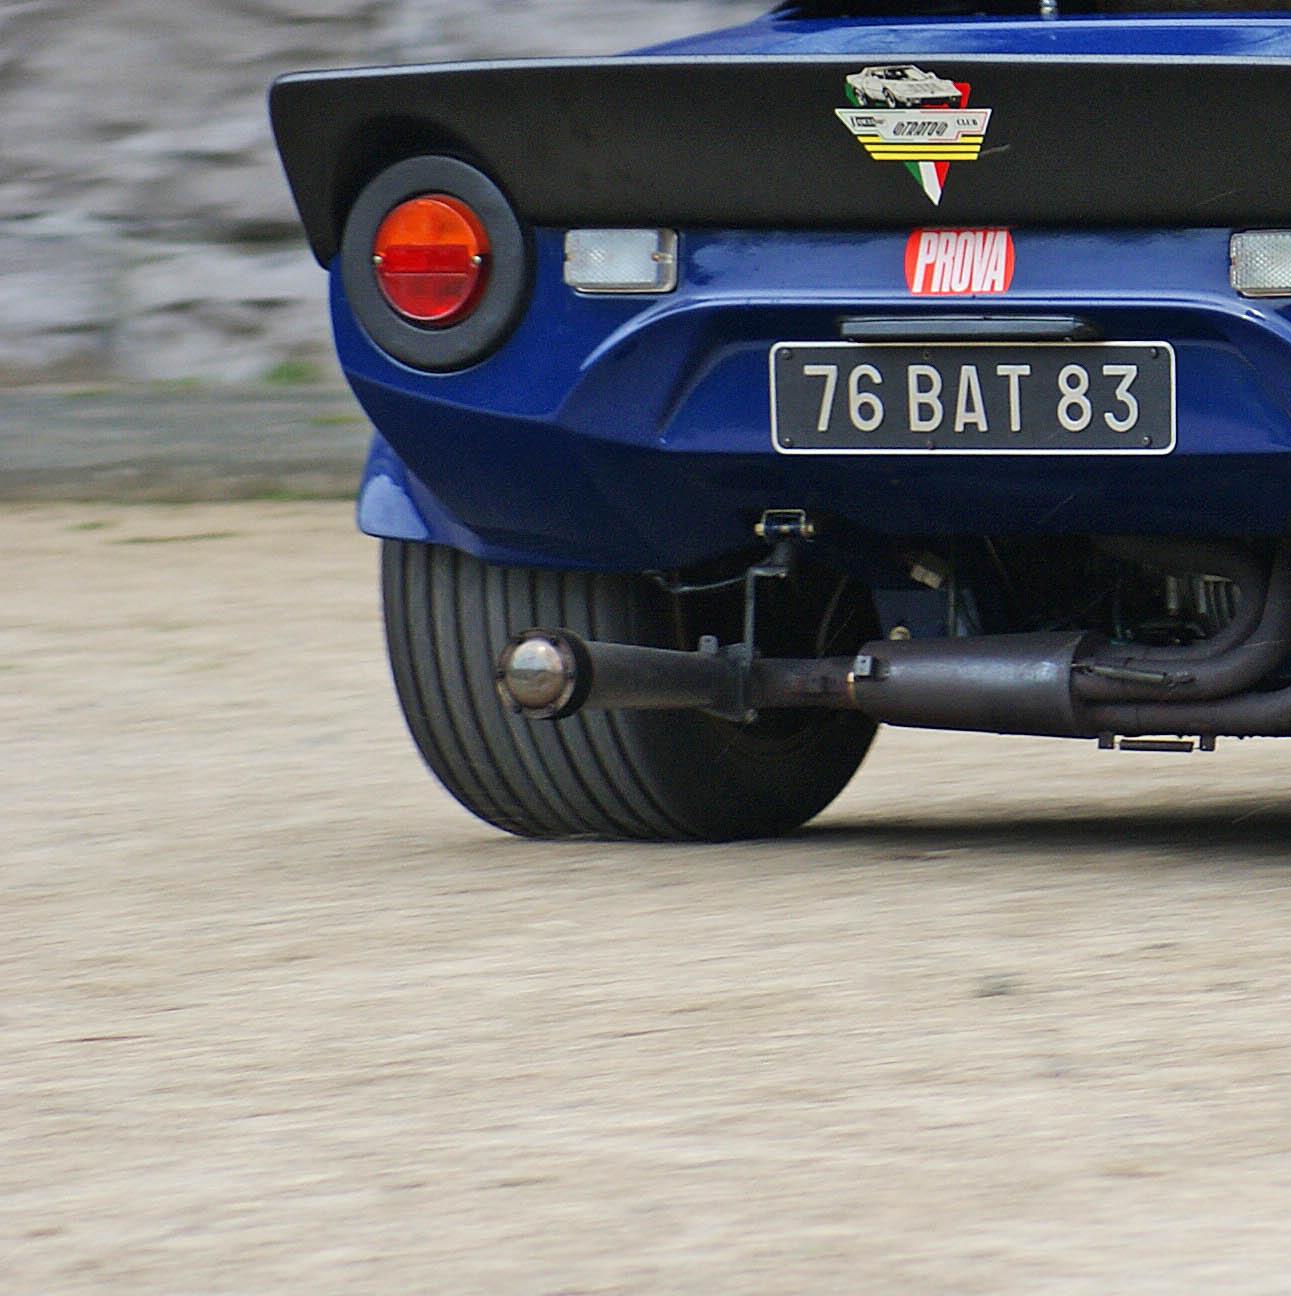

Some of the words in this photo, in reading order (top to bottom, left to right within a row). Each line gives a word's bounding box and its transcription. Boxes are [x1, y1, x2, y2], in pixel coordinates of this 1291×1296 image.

[911, 231, 1007, 294] PROVA
[803, 364, 885, 433] 76
[907, 364, 1031, 433] BAT
[1056, 364, 1140, 433] 83
